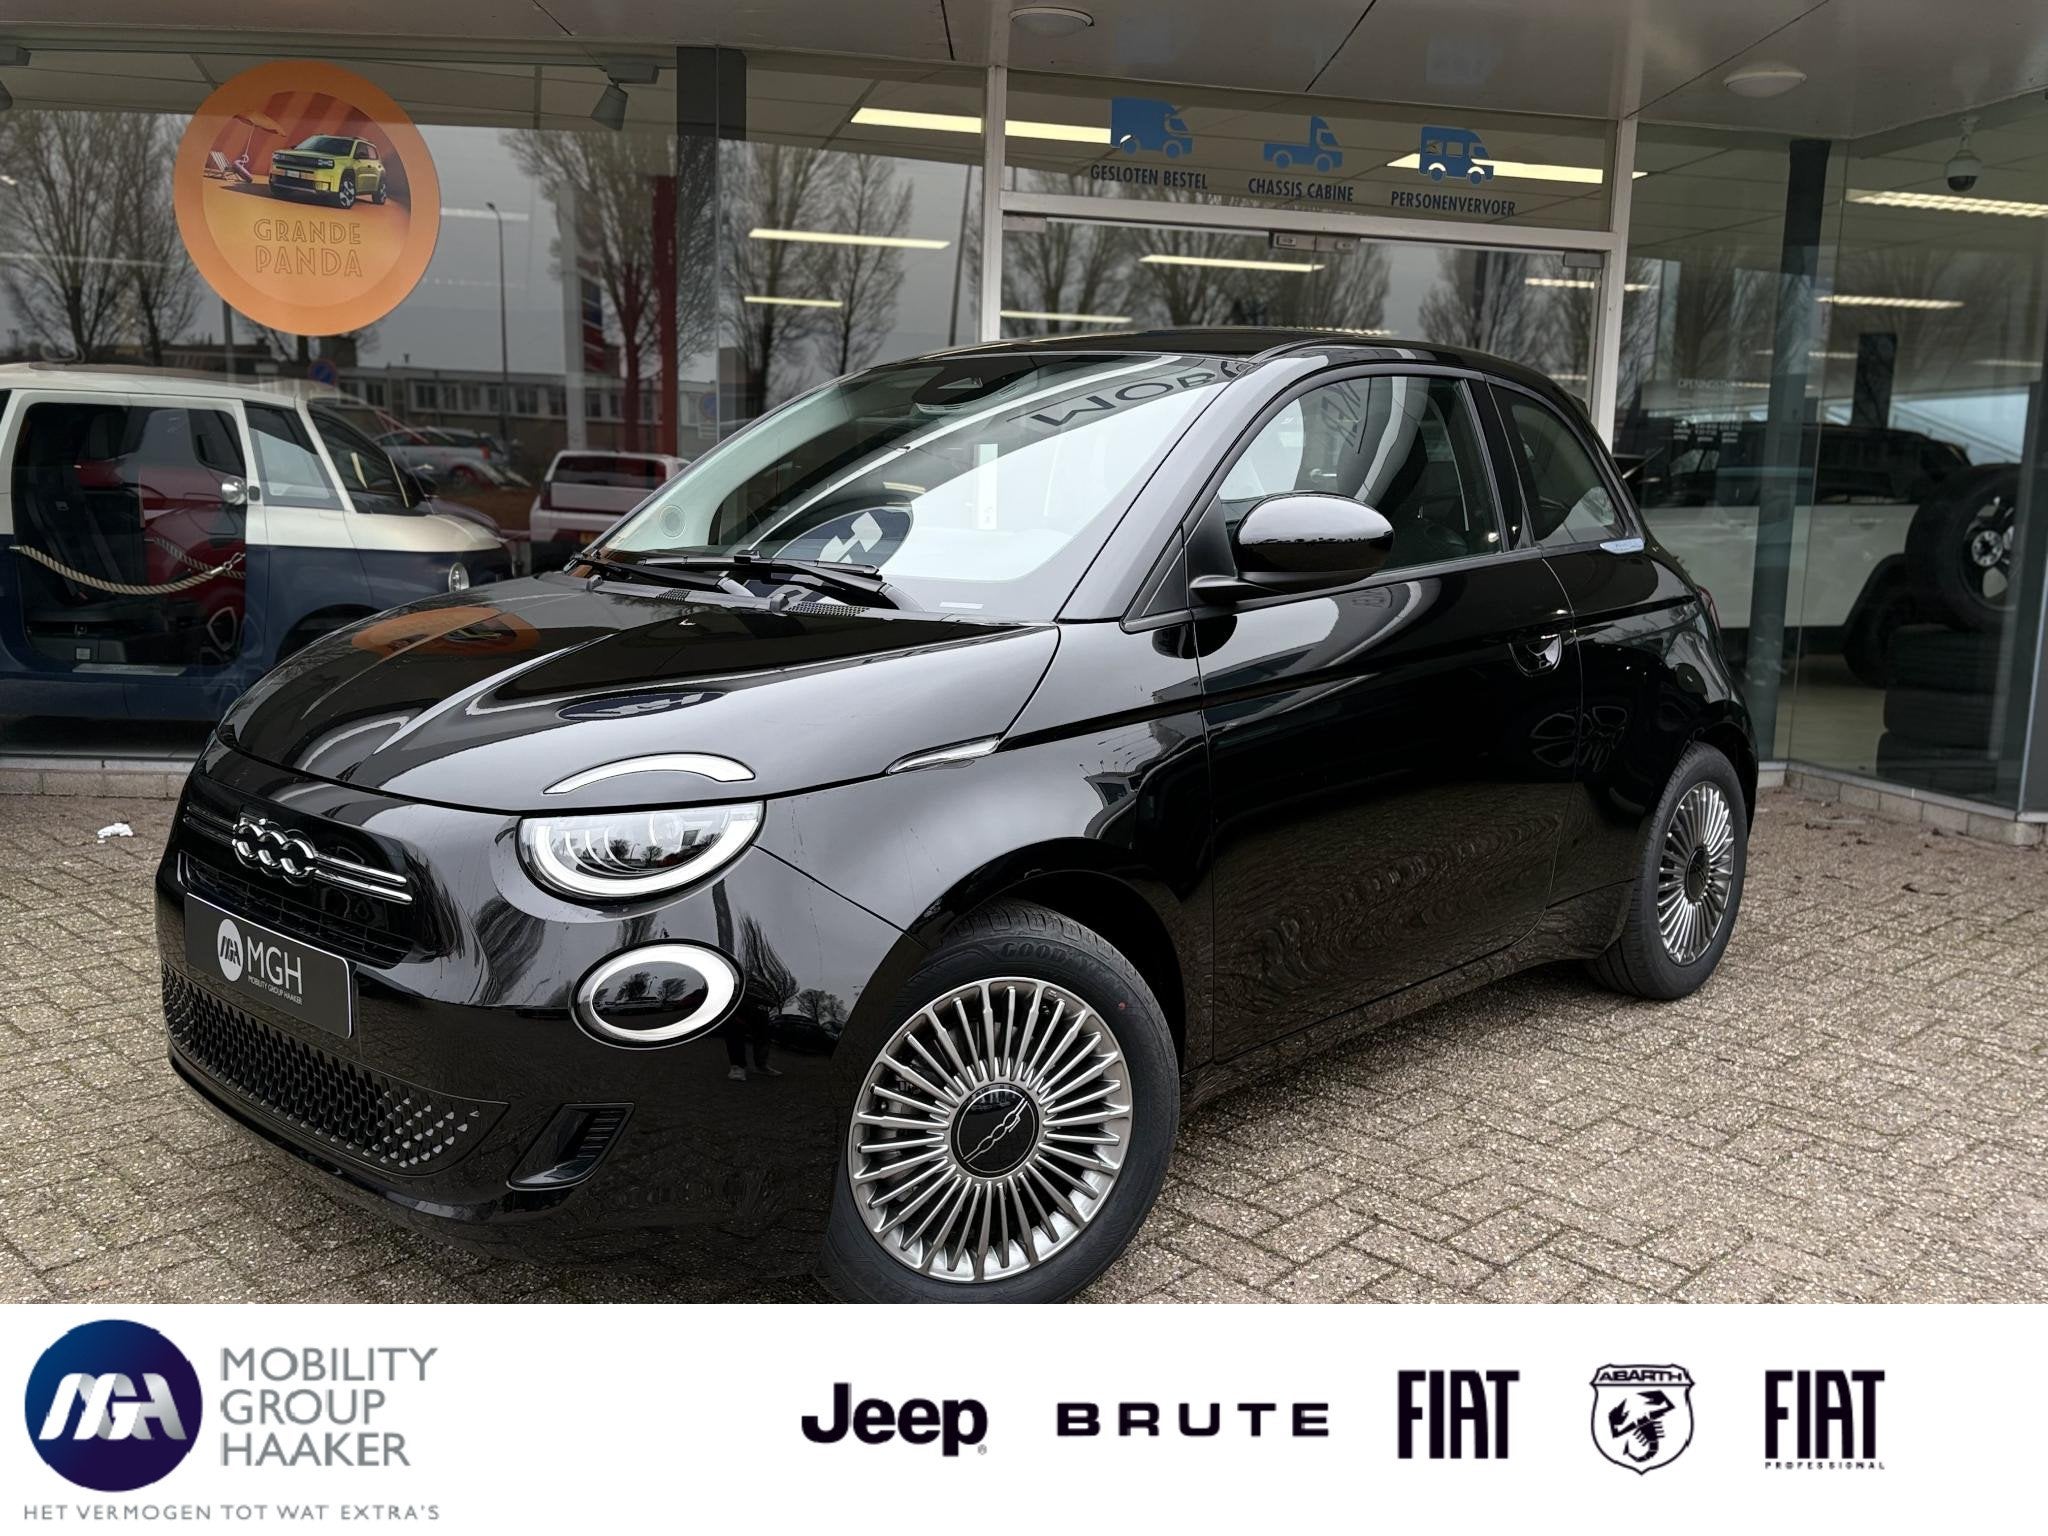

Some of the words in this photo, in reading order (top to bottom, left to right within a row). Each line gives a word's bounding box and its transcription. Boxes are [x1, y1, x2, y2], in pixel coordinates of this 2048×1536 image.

[1090, 164, 1158, 188] GESLOTEN
[1163, 170, 1208, 190] BESTEL
[1247, 178, 1304, 198] CHASSIS
[1307, 183, 1354, 202] CABINE
[1390, 190, 1516, 217] PERSONENVERVOER
[253, 218, 361, 245] GRANDE
[255, 245, 362, 277] PANDA
[247, 936, 303, 995] MGH
[247, 975, 268, 989] MOBILITY
